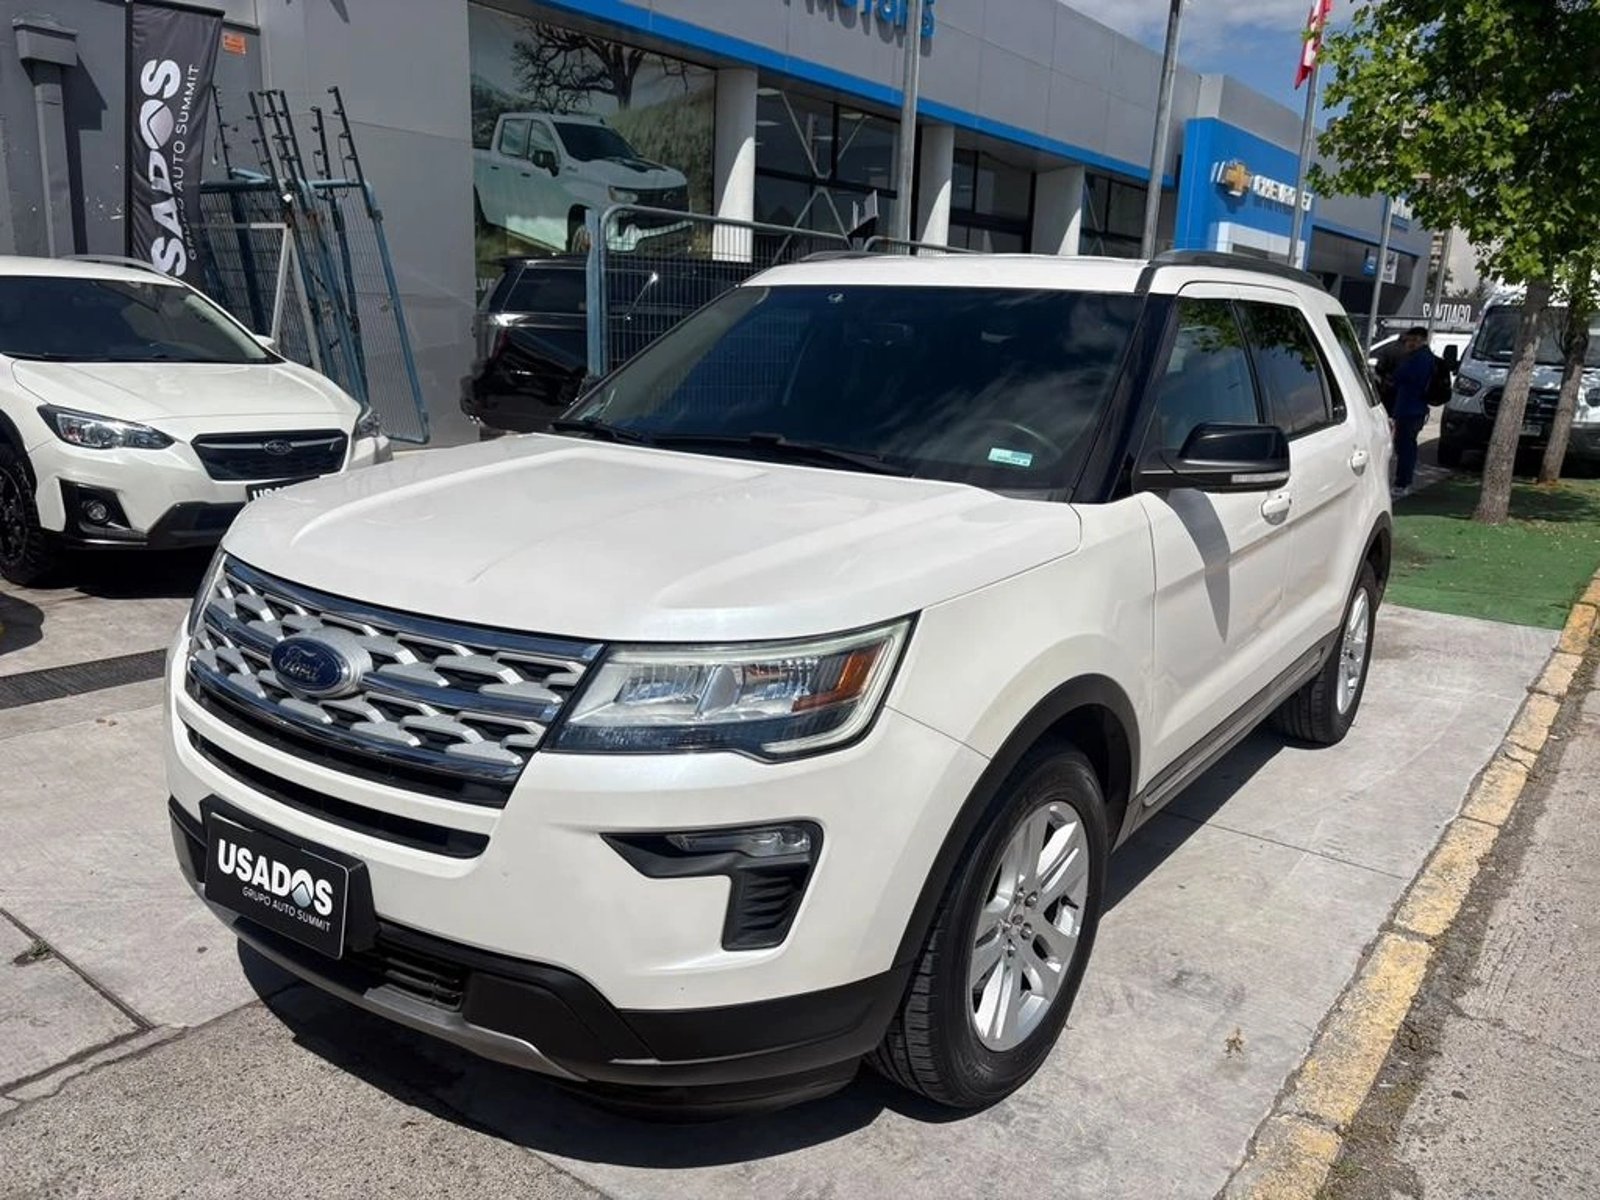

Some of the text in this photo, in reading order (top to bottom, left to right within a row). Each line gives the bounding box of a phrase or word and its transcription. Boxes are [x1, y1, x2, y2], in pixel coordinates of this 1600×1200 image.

[175, 64, 200, 135] SUMMIT
[139, 60, 187, 276] SADOS
[173, 141, 186, 192] AUTO
[218, 839, 333, 916] USADOS
[242, 886, 331, 932] GRUPO AUTO SUMMIT
